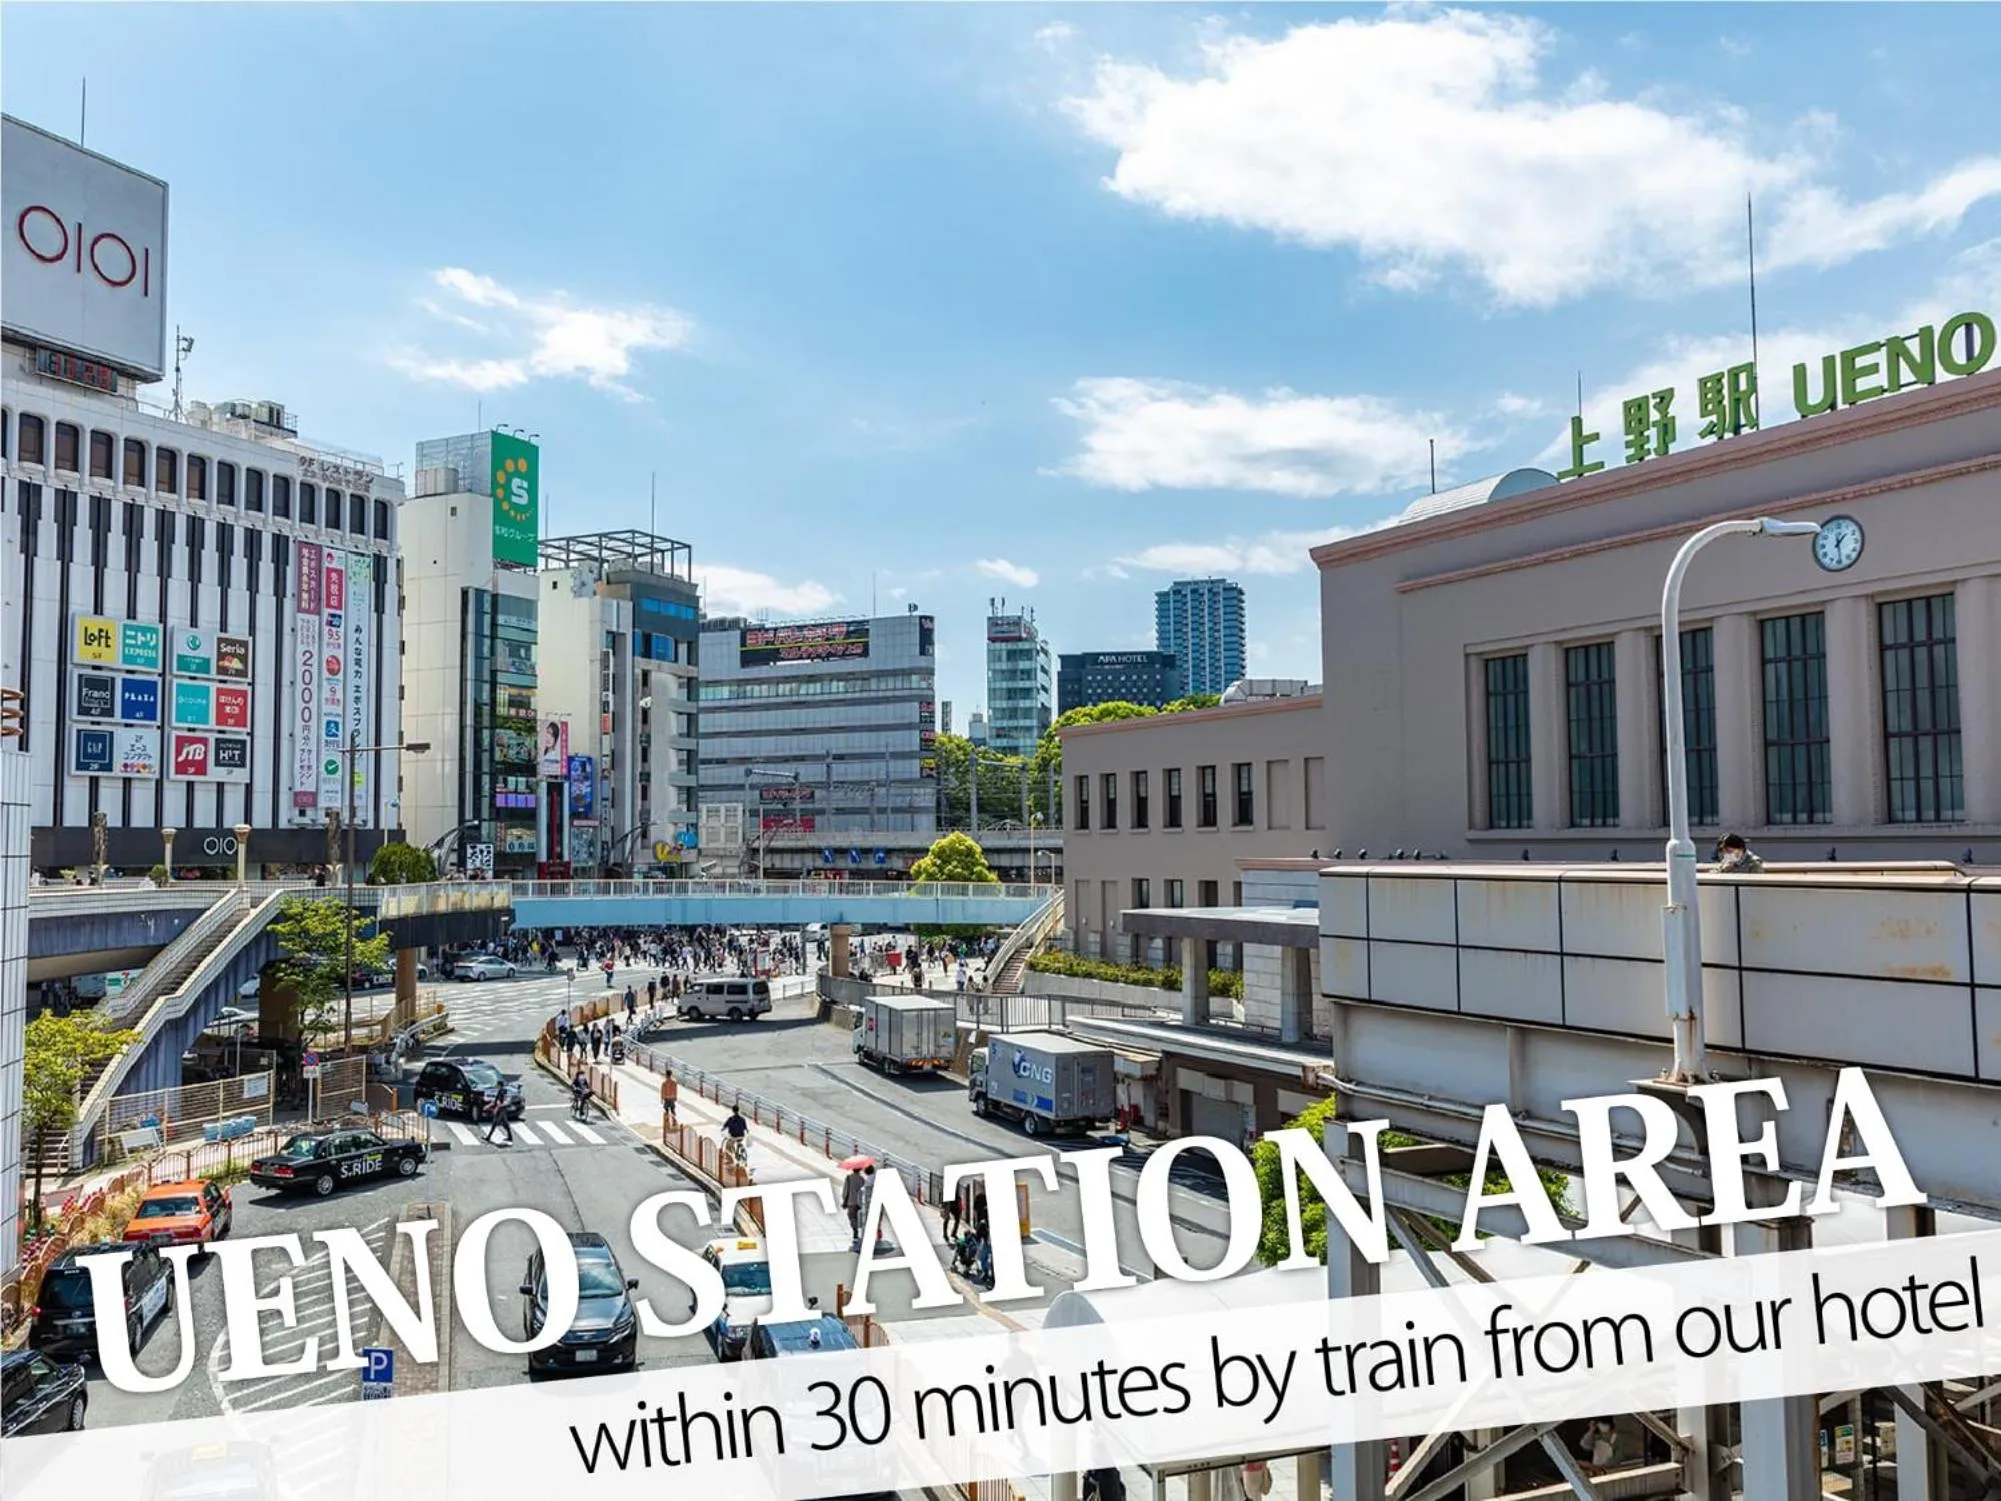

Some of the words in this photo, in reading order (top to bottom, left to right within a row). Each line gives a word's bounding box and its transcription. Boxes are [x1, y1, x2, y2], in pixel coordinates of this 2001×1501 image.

[1793, 312, 1998, 419] UENO
[1557, 362, 1760, 479] 上野駅
[84, 626, 111, 648] Loft
[125, 630, 157, 647] ニトリ
[219, 642, 245, 654] Seria
[1098, 655, 1117, 663] APA
[1118, 655, 1148, 663] HOTEL
[124, 692, 155, 702] PLAZA
[177, 743, 205, 762] JTB
[1020, 1061, 1053, 1084] CNG
[341, 1159, 383, 1178] S.RIDE
[370, 1352, 388, 1379] P
